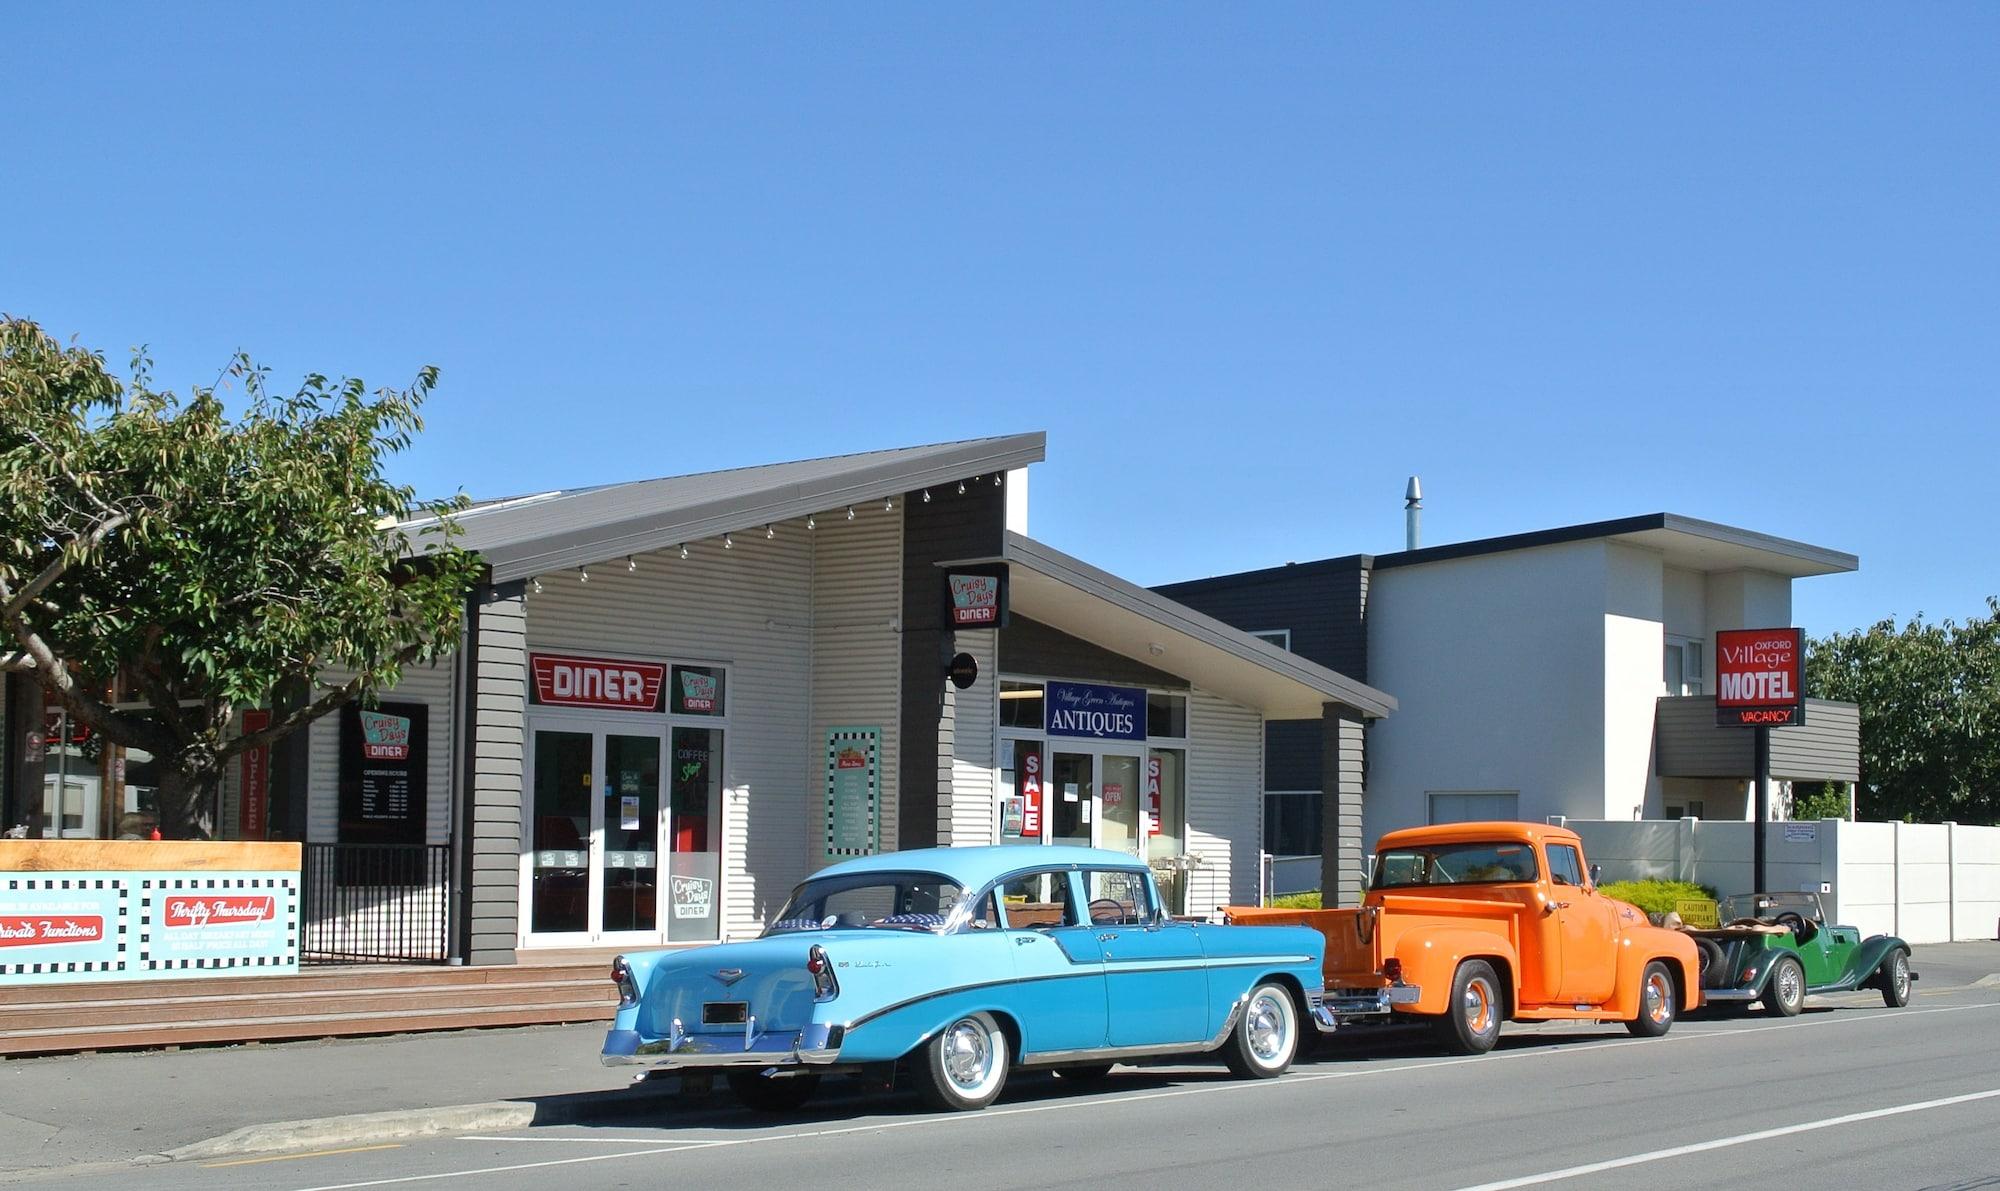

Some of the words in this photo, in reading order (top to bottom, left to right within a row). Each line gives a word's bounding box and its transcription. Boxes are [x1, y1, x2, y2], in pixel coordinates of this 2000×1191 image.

[953, 578, 986, 595] Cruisy
[967, 590, 994, 605] Days
[960, 608, 991, 621] DINER
[1755, 640, 1792, 650] OXFORD
[1723, 645, 1792, 669] Village
[553, 665, 645, 702] DINER
[1721, 671, 1795, 700] MOTEL
[687, 699, 711, 709] DINER
[1057, 687, 1081, 707] Village
[365, 715, 400, 731] Cruisy
[1051, 709, 1134, 736] ANTIQUES
[1741, 710, 1792, 723] VACANCY
[378, 727, 406, 743] Days
[371, 745, 402, 757] DINER
[677, 749, 708, 761] COFFEE
[248, 747, 259, 830] OFFEE
[1025, 755, 1040, 831] SALE
[1104, 791, 1122, 802] OPEN
[1147, 760, 1160, 831] SALE
[674, 879, 703, 894] Cruisy
[685, 889, 708, 904] Days
[170, 900, 211, 928] Thrifty
[211, 896, 271, 928] Thursday!
[680, 906, 705, 916] DINER
[1683, 903, 1707, 913] CAUTION
[39, 920, 98, 938] Functions
